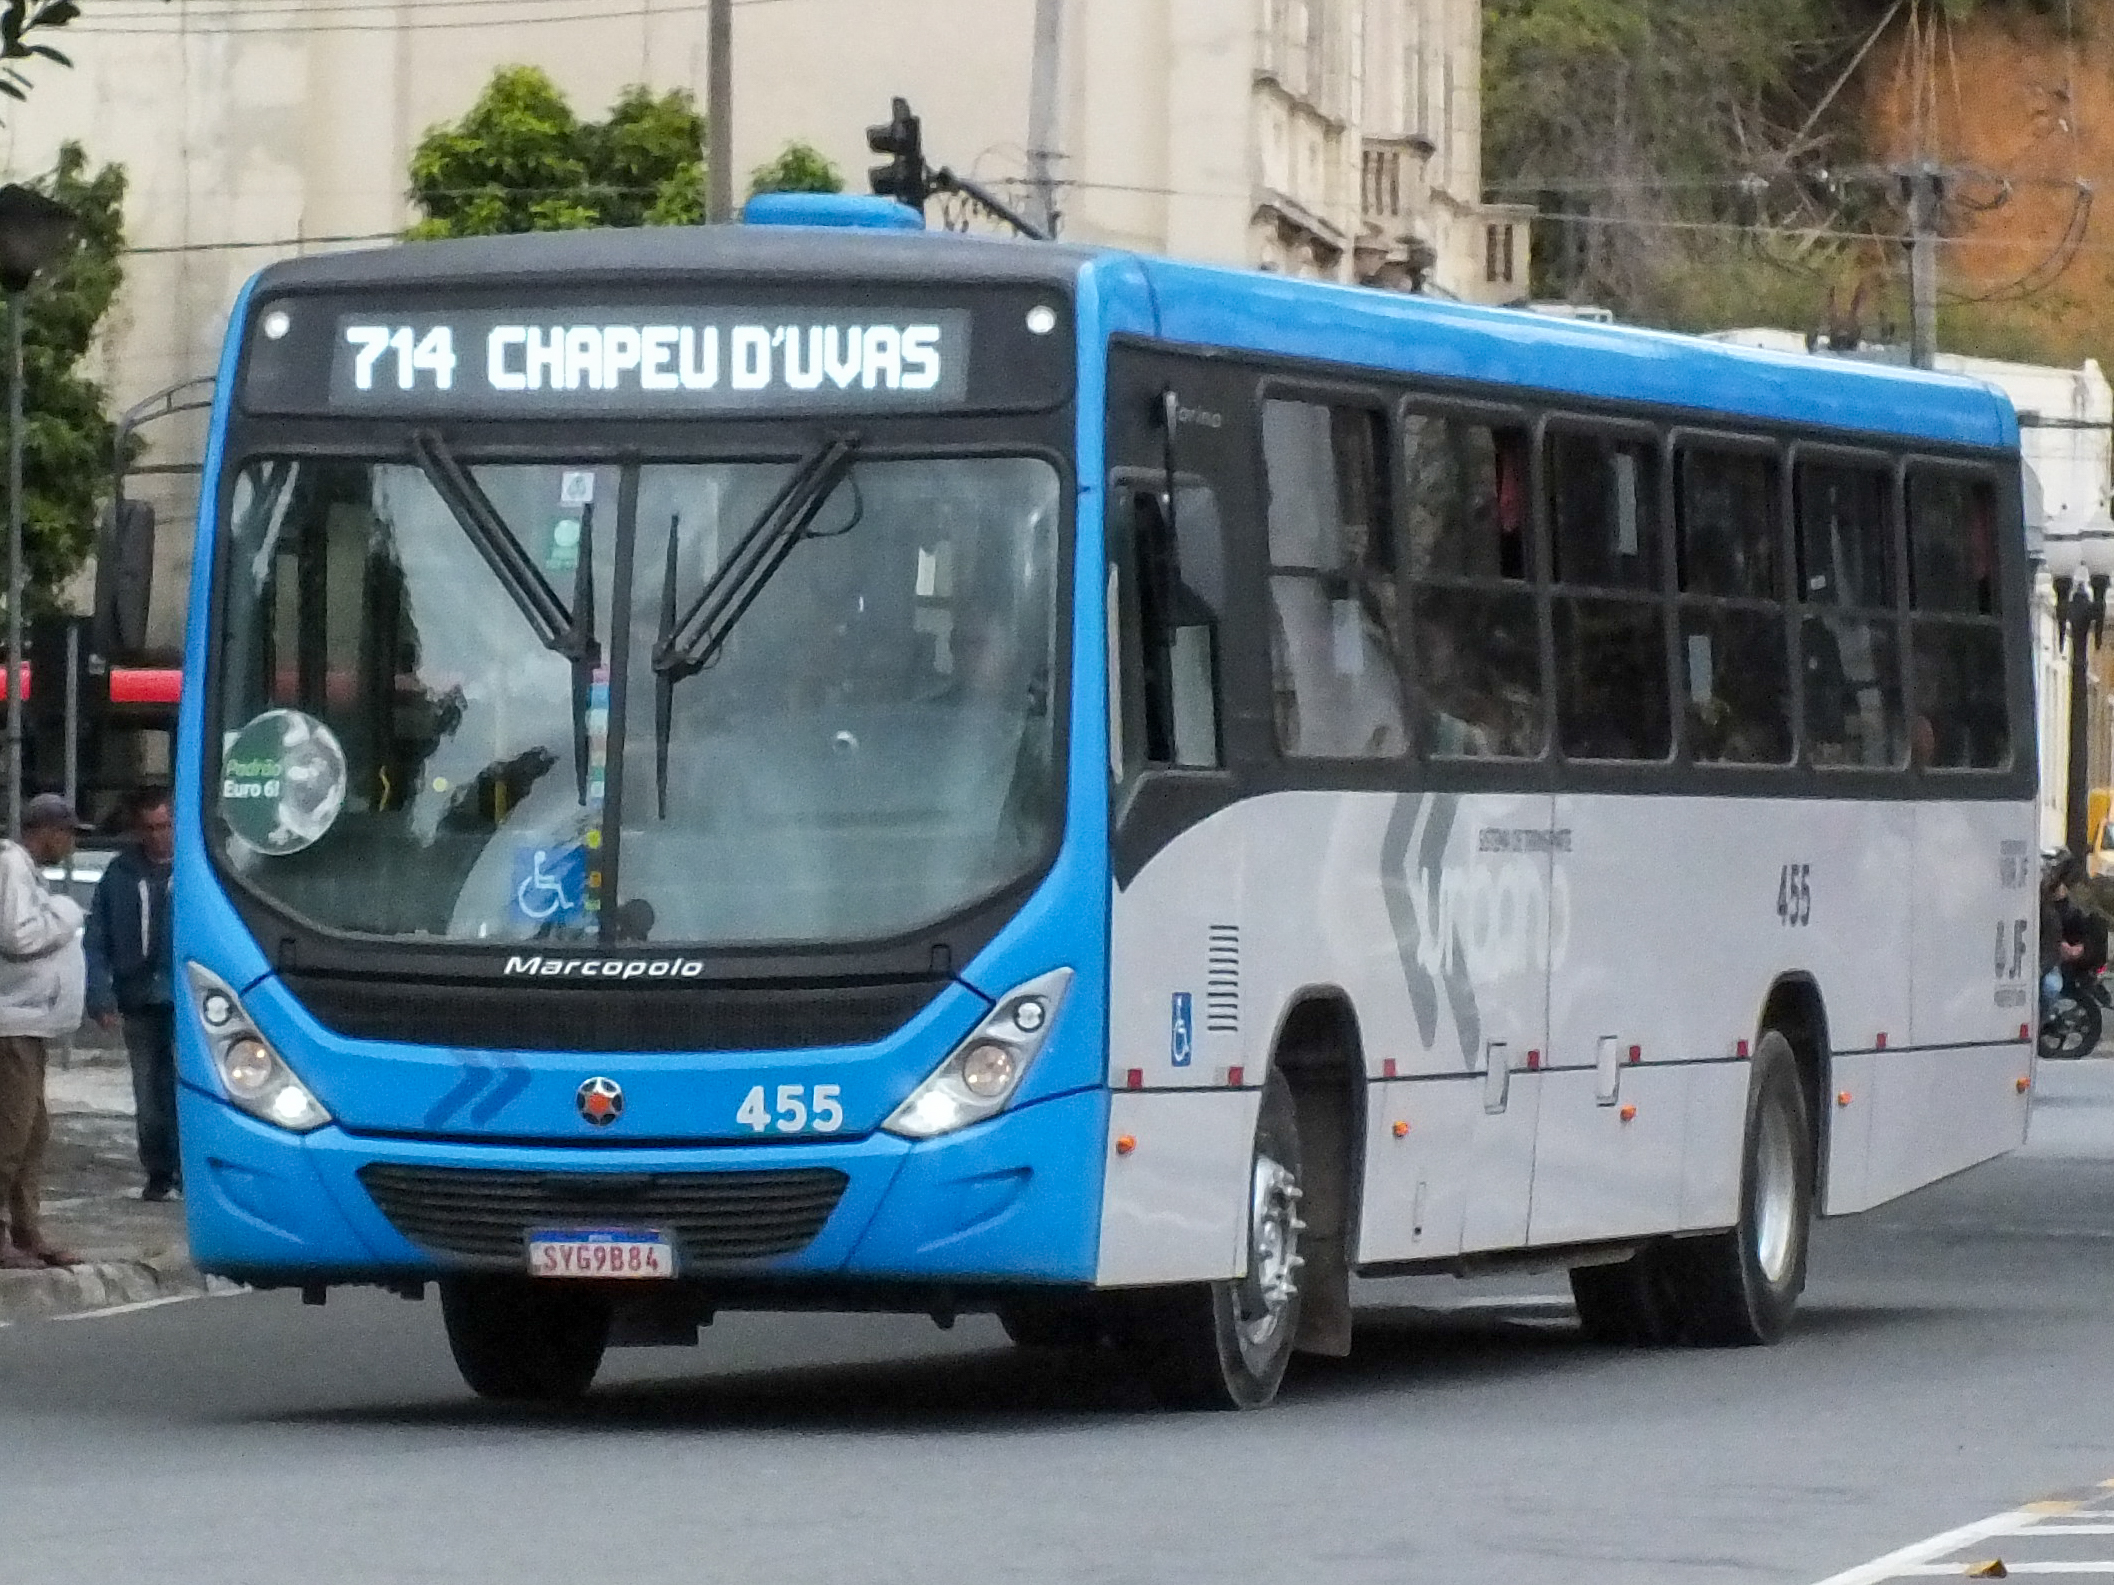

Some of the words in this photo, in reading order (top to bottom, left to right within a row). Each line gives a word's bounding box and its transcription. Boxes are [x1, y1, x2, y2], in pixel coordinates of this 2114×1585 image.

[346, 325, 457, 390] 714
[487, 325, 719, 390] CHAPEU
[732, 325, 940, 390] D'UVAS
[223, 780, 262, 798] Euro
[1776, 863, 1811, 927] 455
[503, 956, 704, 980] Marcopolo
[736, 1084, 843, 1133] 455
[543, 1245, 659, 1272] SYG9B84
